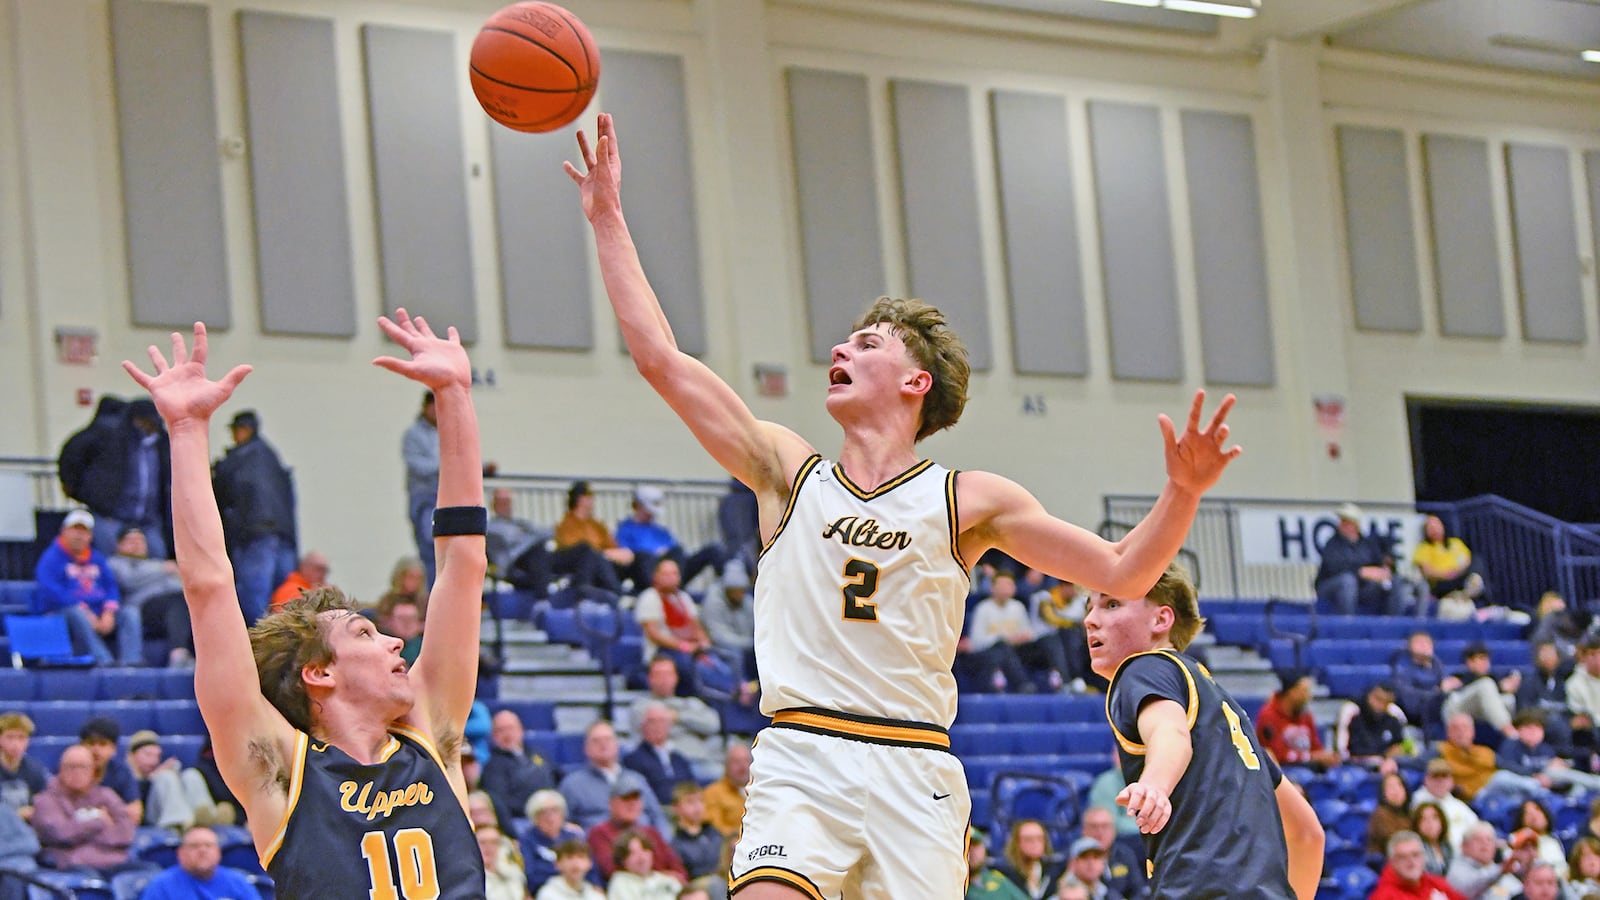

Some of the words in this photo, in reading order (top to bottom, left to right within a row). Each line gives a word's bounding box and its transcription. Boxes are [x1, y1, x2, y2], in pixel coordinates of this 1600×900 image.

[822, 516, 912, 550] Alter
[841, 556, 881, 623] 2
[1222, 701, 1260, 770] 4
[339, 780, 434, 820] Upper
[360, 827, 440, 900] 10
[759, 844, 787, 857] GCL
